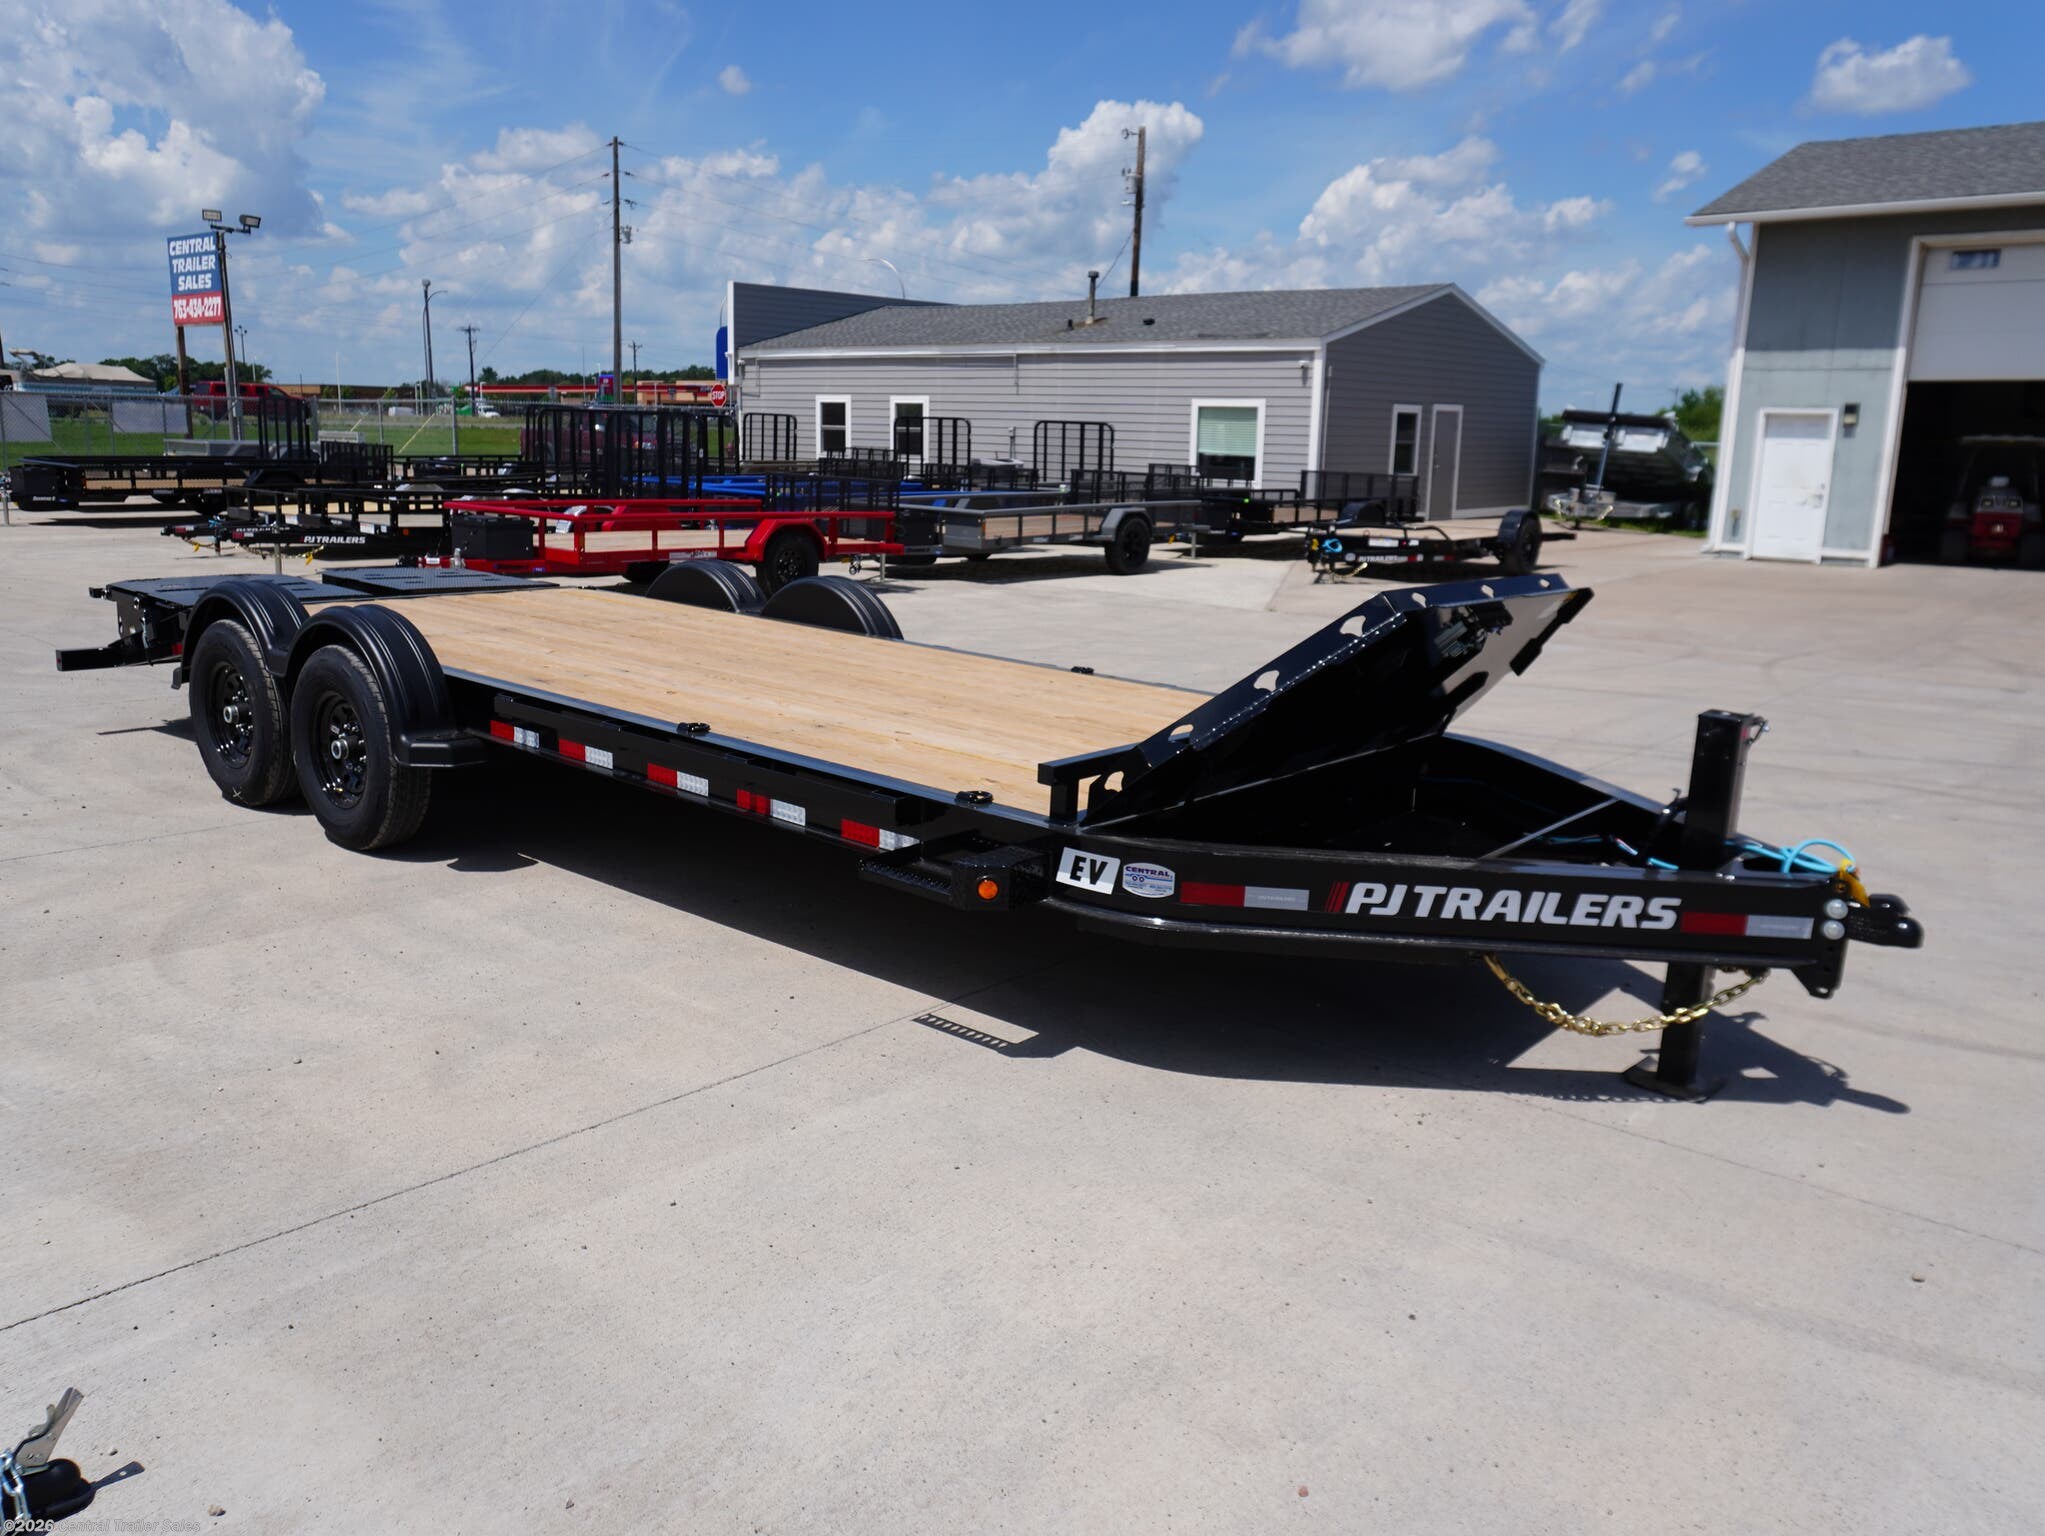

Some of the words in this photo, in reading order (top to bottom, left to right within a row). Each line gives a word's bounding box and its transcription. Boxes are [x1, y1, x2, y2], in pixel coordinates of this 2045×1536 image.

[169, 236, 215, 256] CENTRAL
[172, 254, 216, 273] TRAILER
[178, 273, 212, 291] SALES
[173, 296, 221, 319] 763-434-2277
[712, 391, 725, 400] STOP
[315, 535, 366, 544] TRAILERS
[1069, 855, 1108, 885] EV
[1125, 866, 1170, 877] CENTRAL
[1344, 882, 1407, 916] PJ
[1412, 884, 1682, 931] TRAILERS
